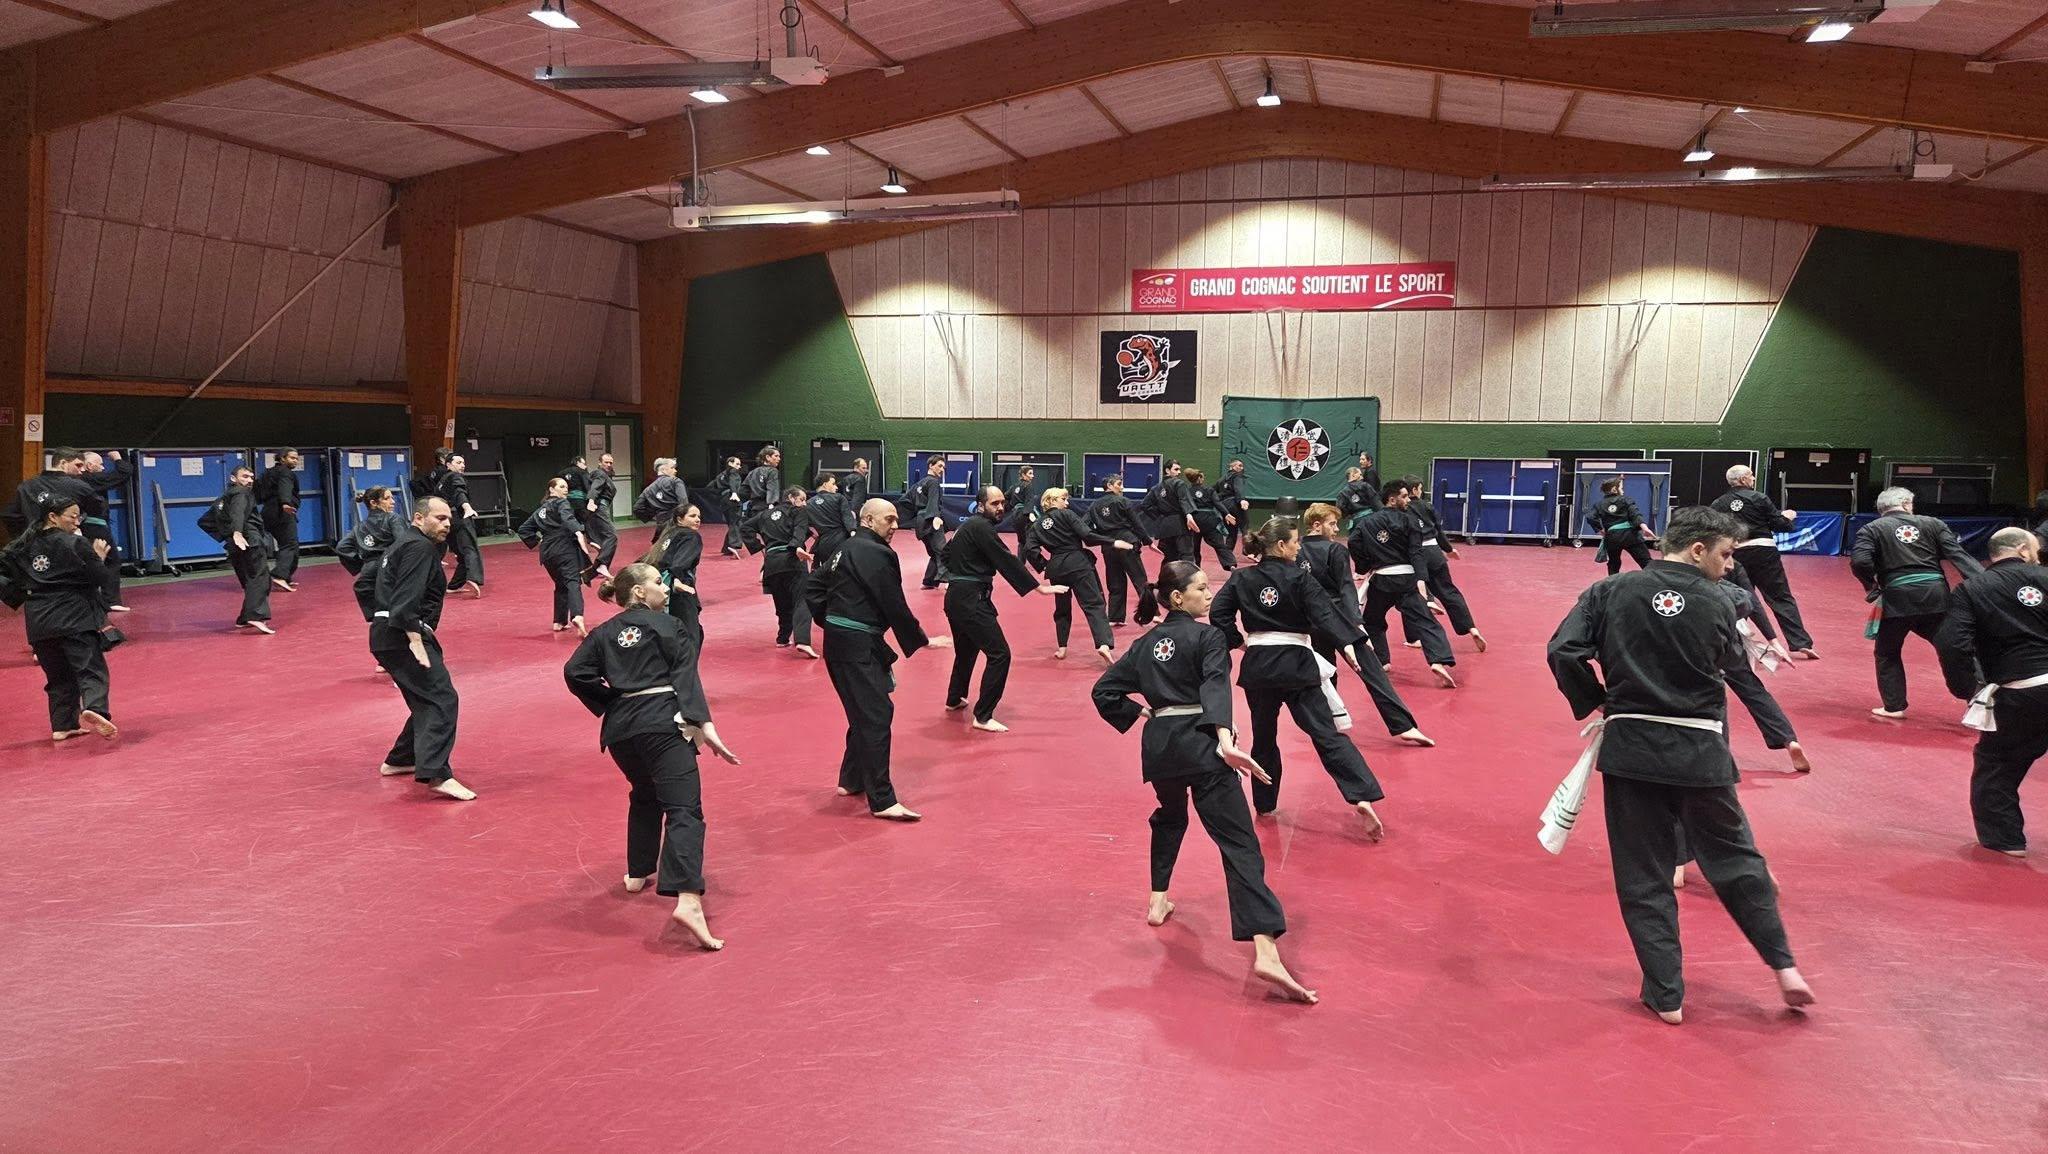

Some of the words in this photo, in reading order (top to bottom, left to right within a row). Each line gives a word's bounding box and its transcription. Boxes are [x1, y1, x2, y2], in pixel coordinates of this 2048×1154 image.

[1190, 278, 1236, 297] GRAND
[1241, 276, 1297, 296] COGNAC
[1302, 274, 1369, 295] SOUTIENT
[1375, 274, 1393, 293] LE
[1399, 273, 1445, 292] SPORT
[1139, 287, 1177, 297] GRAND
[1139, 296, 1177, 304] COGNAC
[1122, 382, 1164, 392] UACTT
[1289, 440, 1309, 459] 仁
